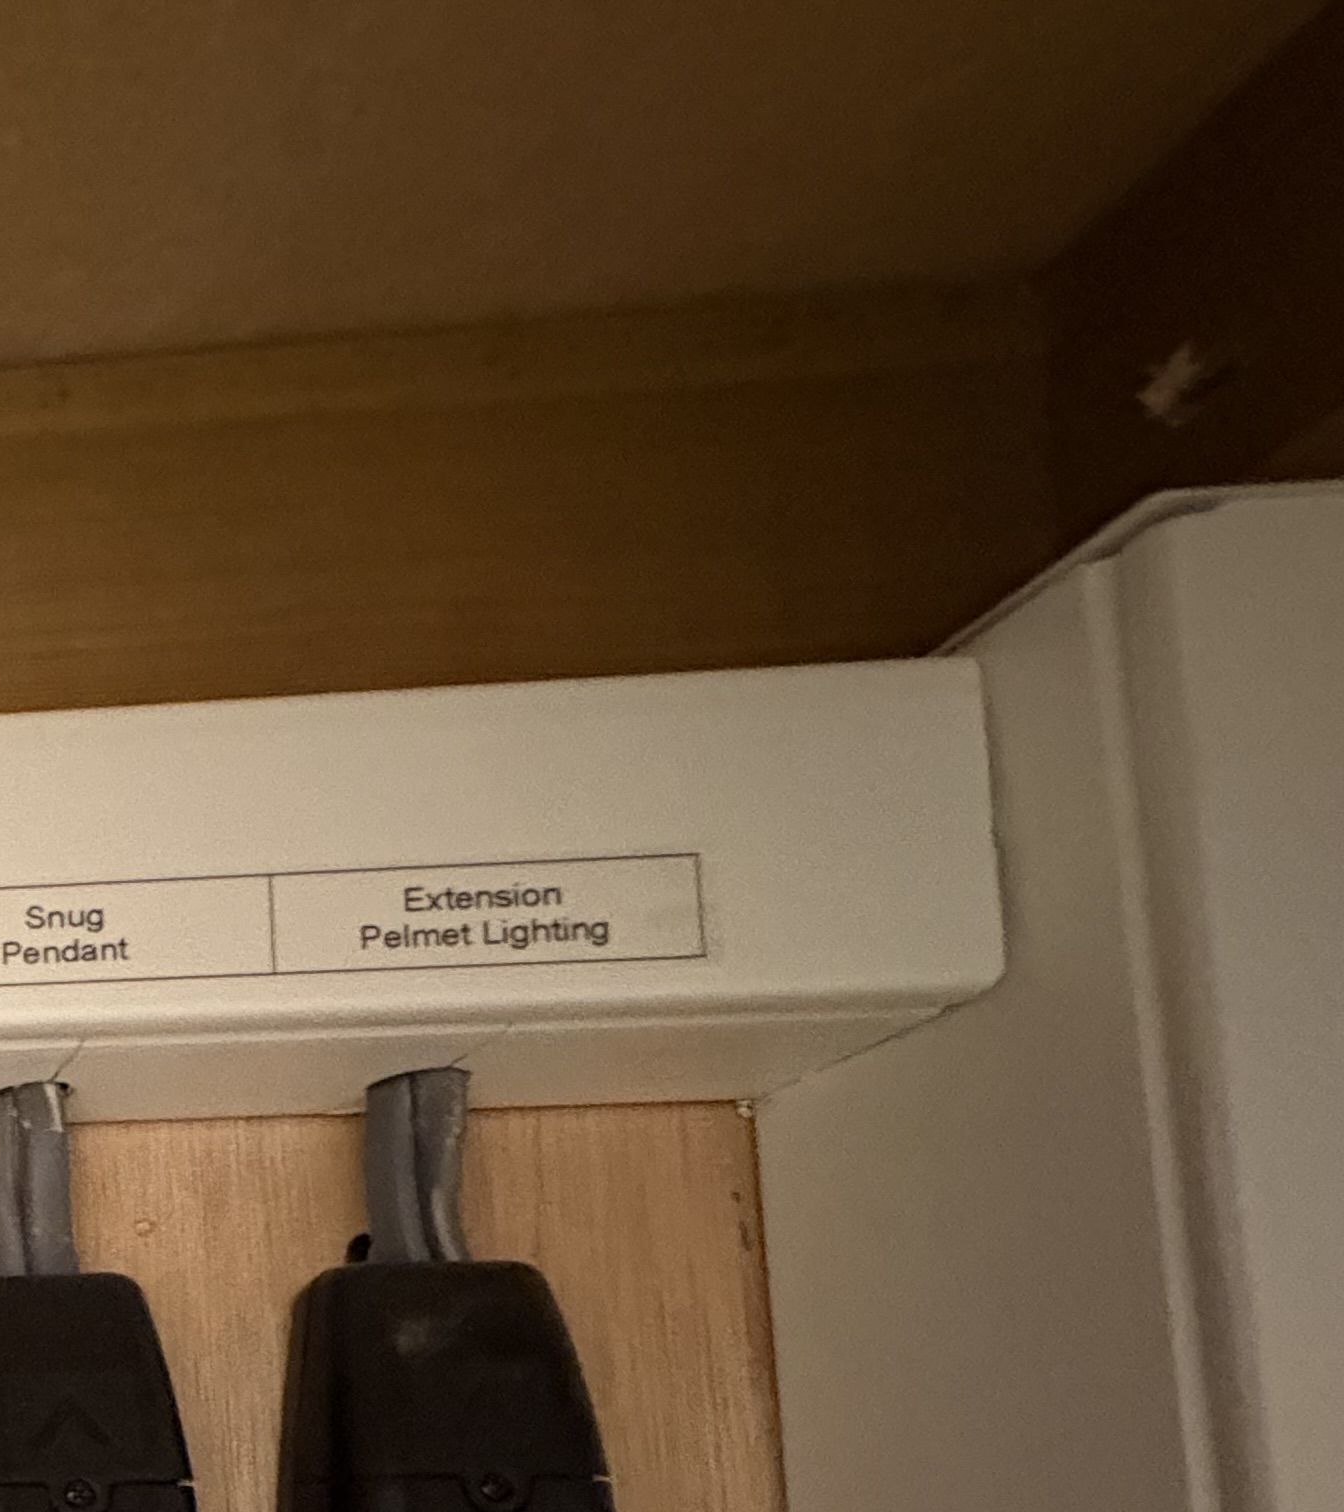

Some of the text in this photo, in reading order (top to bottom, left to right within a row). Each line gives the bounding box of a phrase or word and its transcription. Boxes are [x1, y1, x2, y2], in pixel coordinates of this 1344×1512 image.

[404, 884, 562, 913] Extension
[24, 905, 104, 934] Snug
[361, 918, 609, 951] Pelmet Lighting
[2, 939, 129, 965] Pendant
